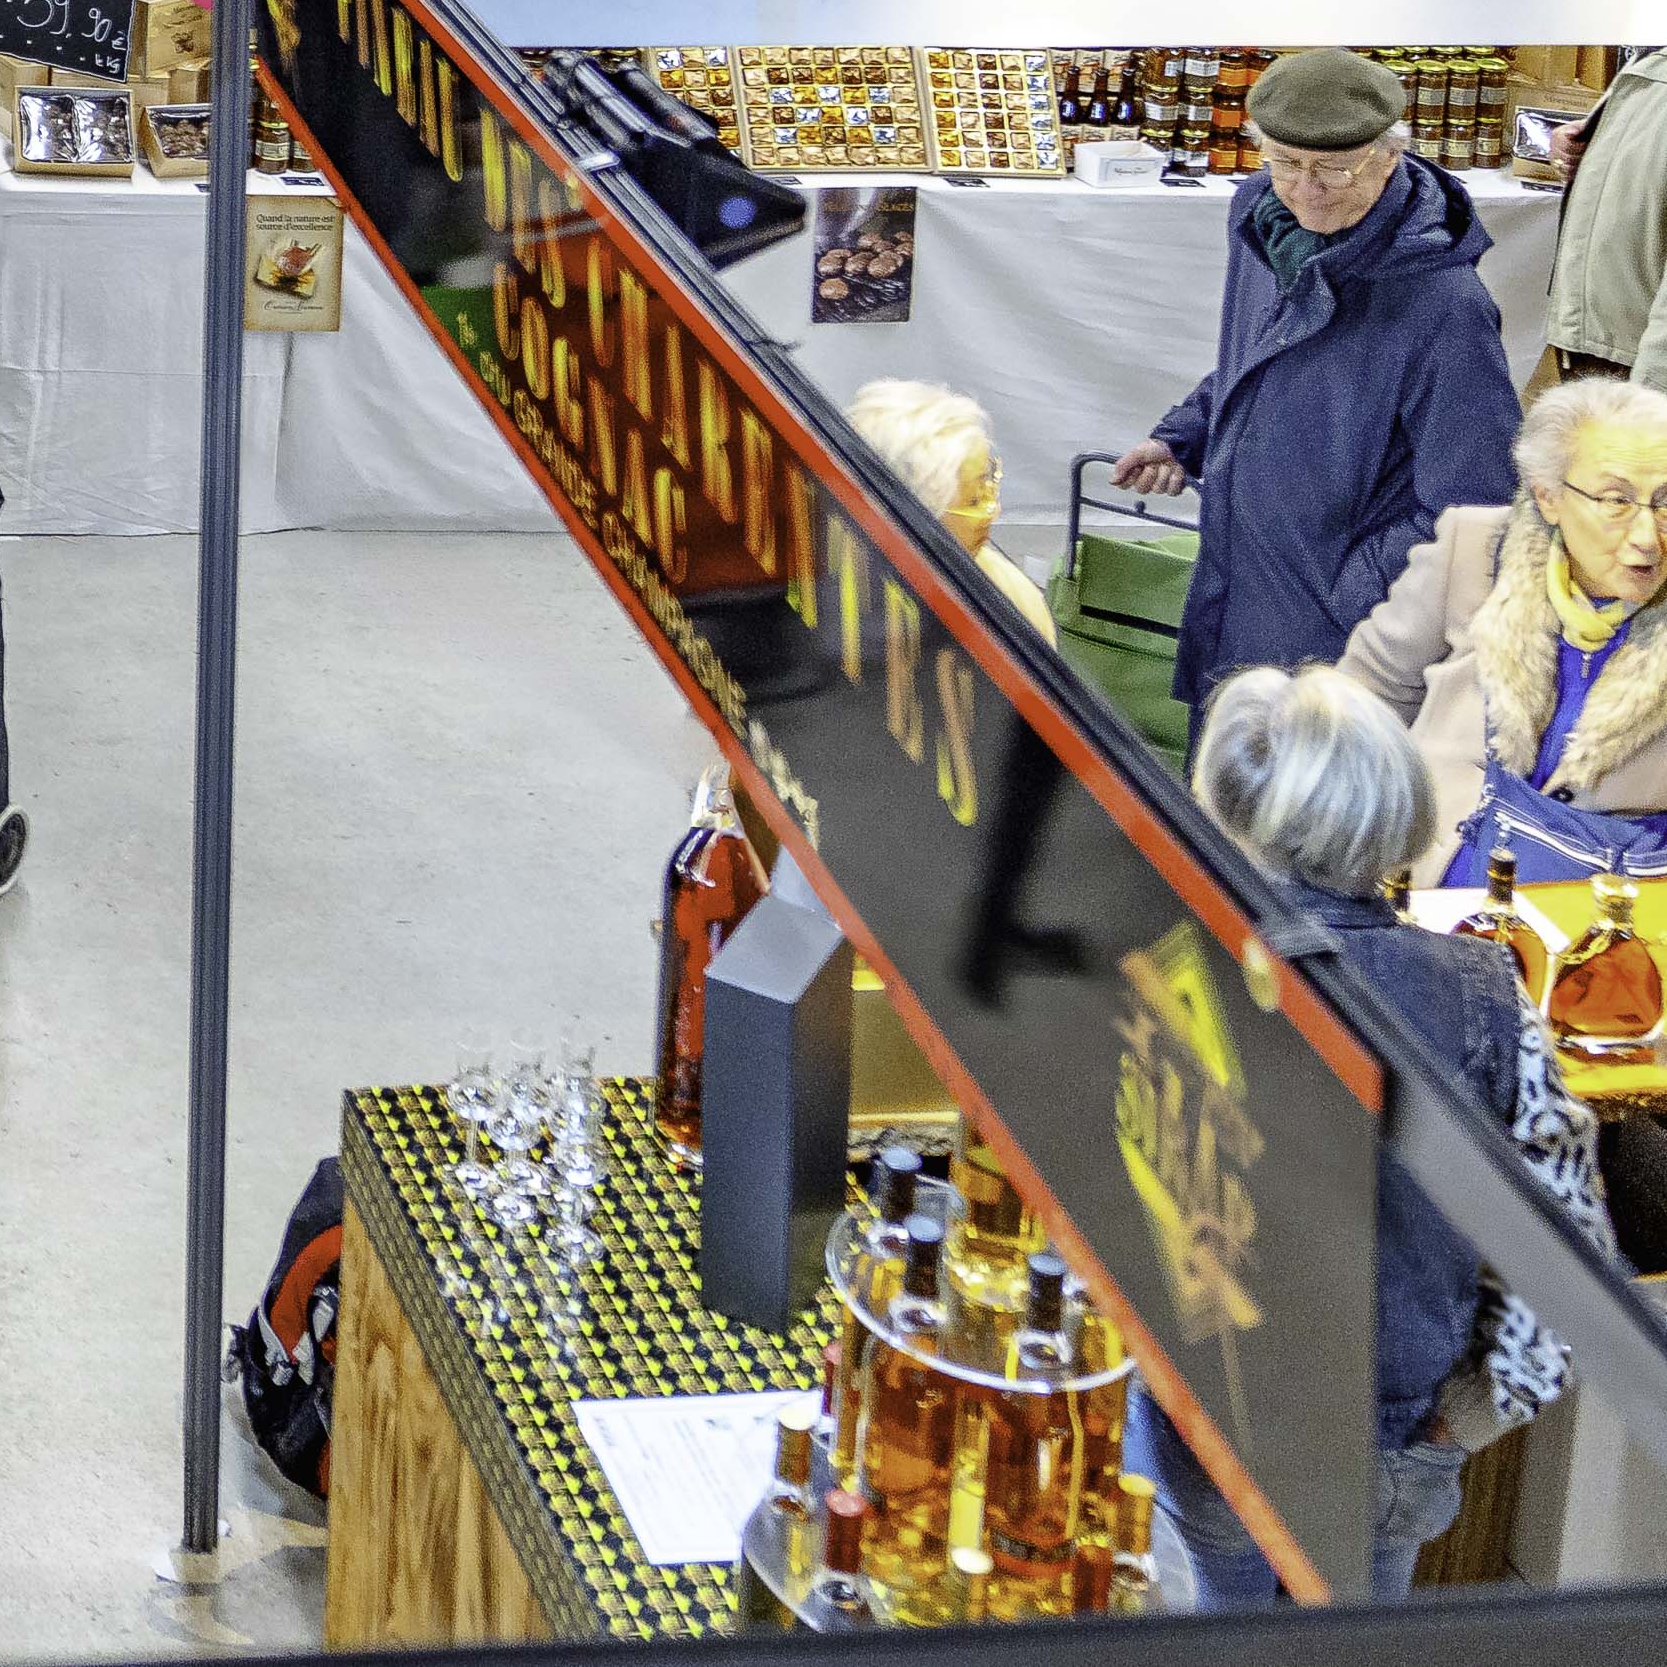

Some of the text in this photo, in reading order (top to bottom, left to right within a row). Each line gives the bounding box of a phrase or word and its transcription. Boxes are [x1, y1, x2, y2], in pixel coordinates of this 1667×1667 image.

[256, 213, 320, 224] Quand la nature
[256, 222, 334, 232] source d'excellence
[493, 254, 685, 586] COGNAC
